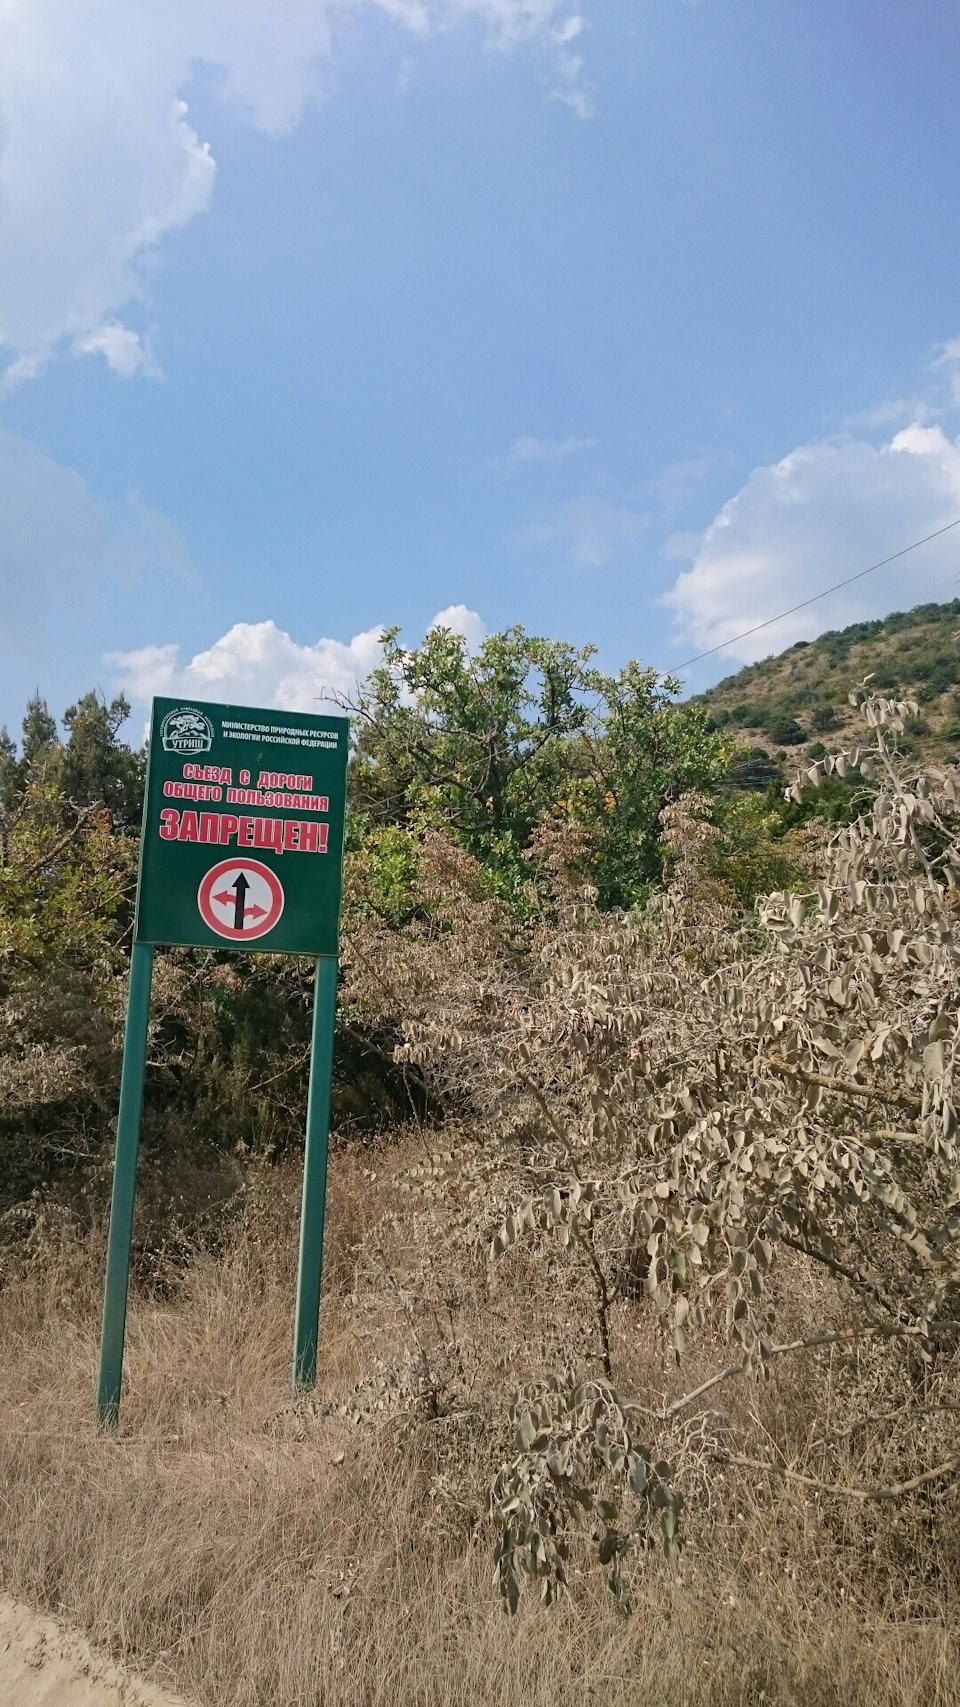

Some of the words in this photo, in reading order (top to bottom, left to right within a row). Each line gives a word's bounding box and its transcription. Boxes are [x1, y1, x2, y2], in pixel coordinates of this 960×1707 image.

[221, 720, 270, 733] МИНИСТЕРСТВО
[270, 725, 310, 737] ПРИРОДНЫХ
[309, 730, 339, 740] РЕСУРСОВ
[223, 730, 229, 738] И
[228, 731, 261, 742] ЭКОЛОГИИ
[261, 734, 300, 746] РОССИЙСКОЙ
[301, 738, 338, 749] ФЕДЕРАЦИИ
[172, 739, 204, 749] УТРИШ
[183, 763, 233, 785] СЪЕЗД
[239, 769, 250, 785] С
[257, 771, 313, 791] ДОРОГИ
[163, 781, 223, 802] ОБЩЕГО
[226, 787, 329, 812] ПОЛЬЗОВАНИЯ
[159, 808, 330, 854] ЗАПРЕЩЕН!
